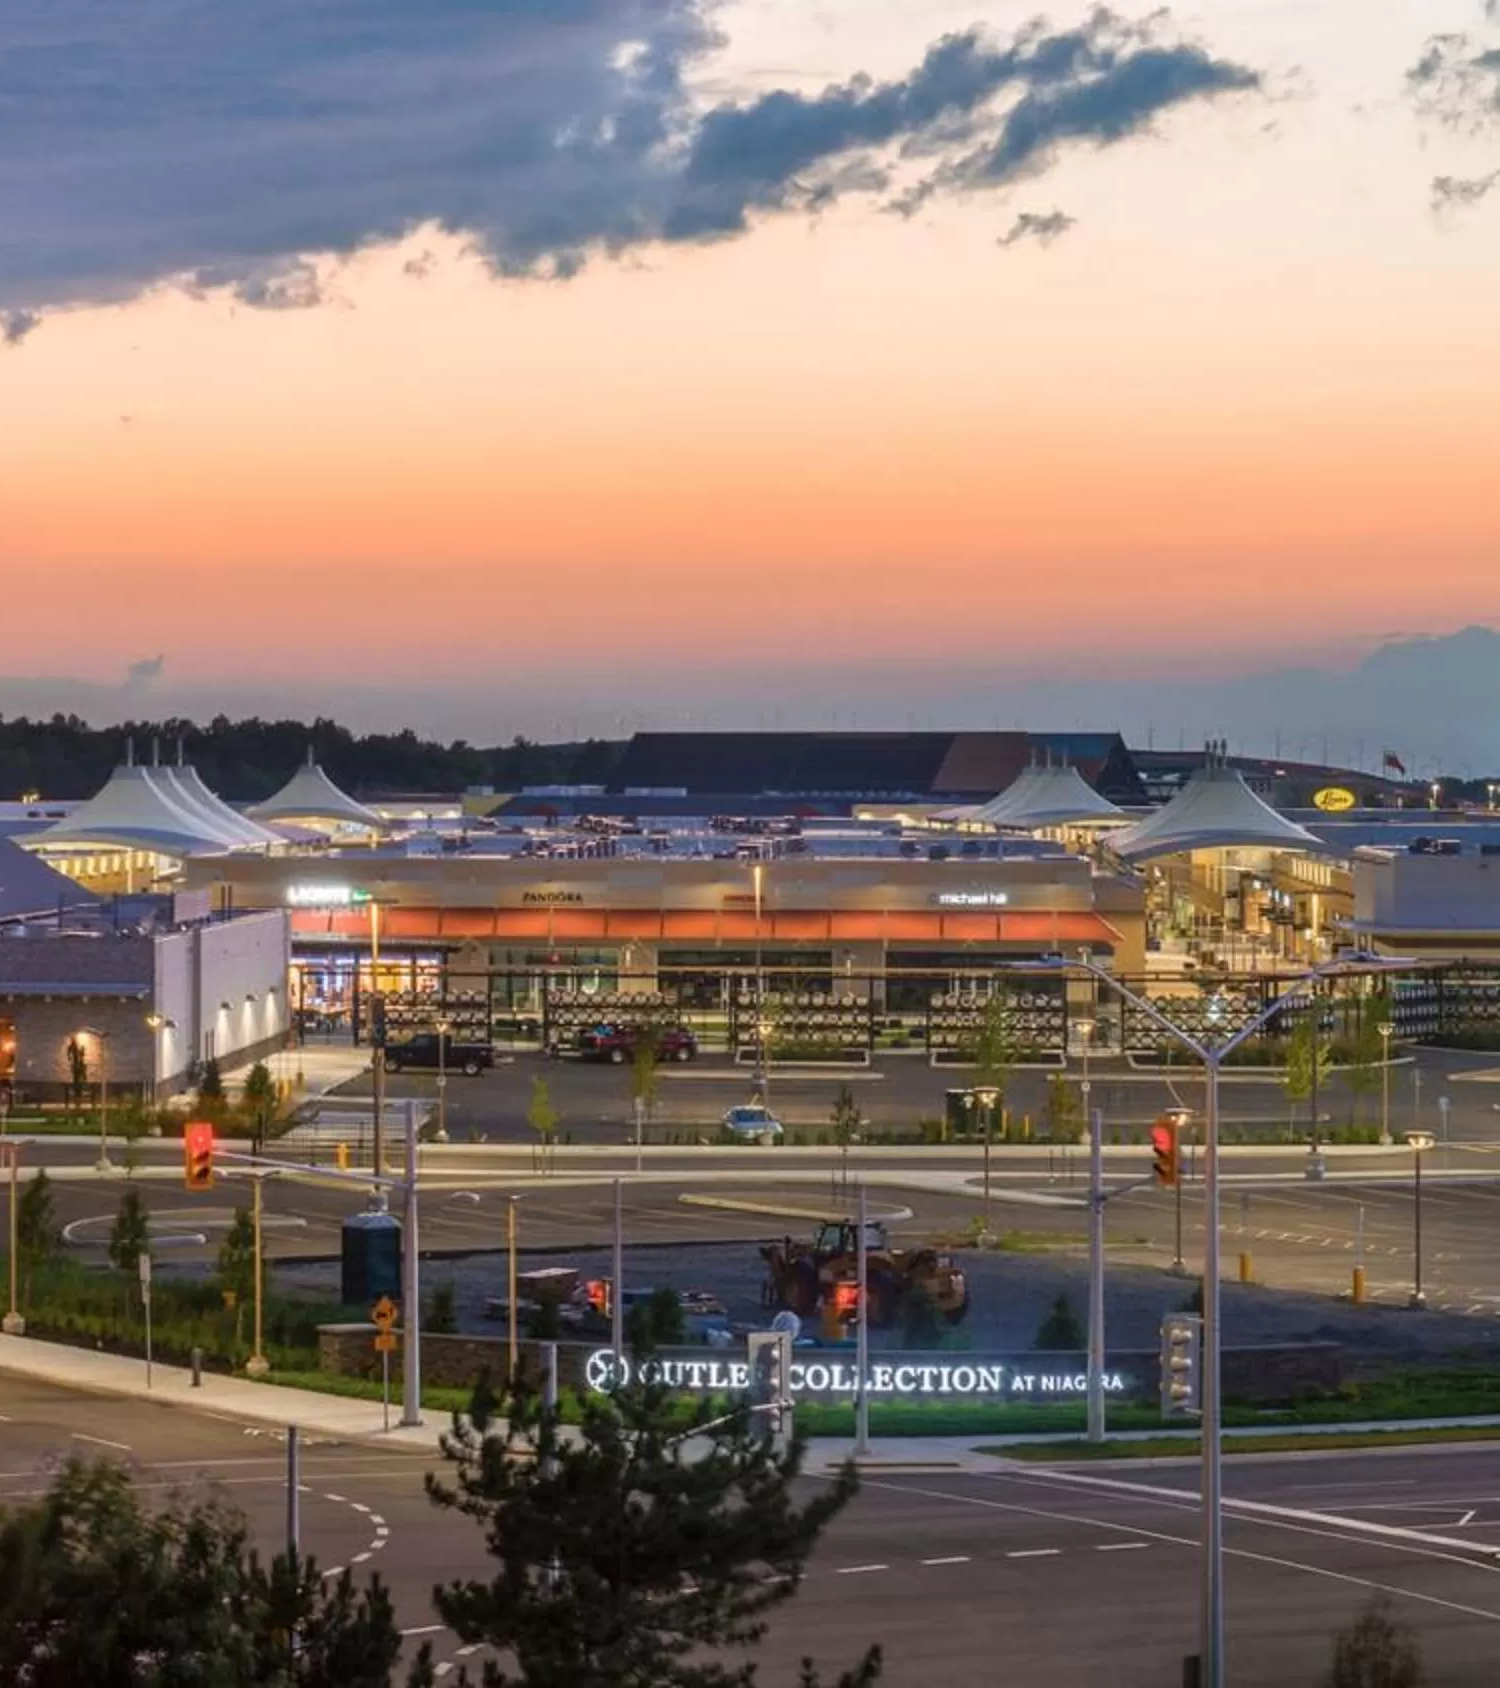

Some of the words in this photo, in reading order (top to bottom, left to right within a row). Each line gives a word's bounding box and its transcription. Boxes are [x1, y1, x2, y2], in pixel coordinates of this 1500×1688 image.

[522, 891, 584, 905] PANDORA
[938, 892, 988, 905] michael
[1010, 1374, 1034, 1392] AT
[1040, 1374, 1124, 1392] NIAGRA
